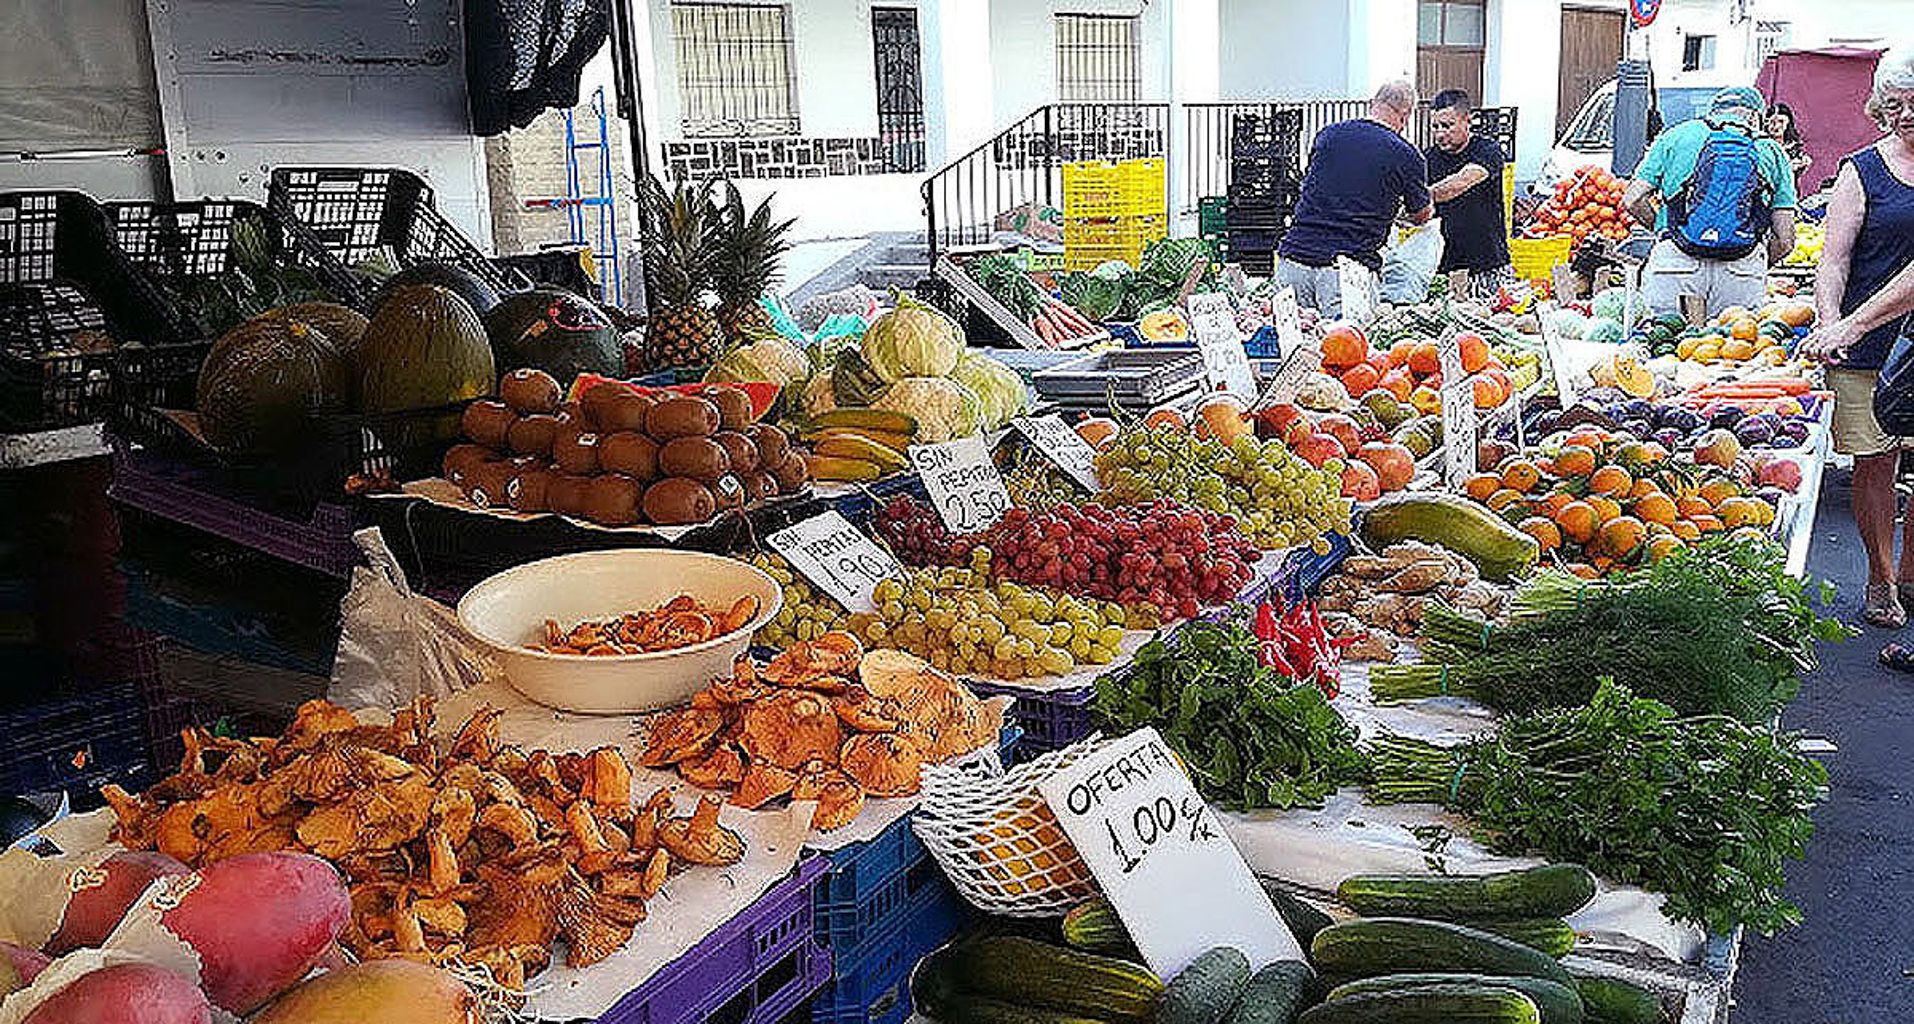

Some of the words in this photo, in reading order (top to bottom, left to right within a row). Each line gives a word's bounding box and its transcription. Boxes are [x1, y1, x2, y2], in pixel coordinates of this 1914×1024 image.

[916, 448, 953, 471] SIN
[773, 529, 801, 551] SIN
[1067, 742, 1175, 815] OFERTA
